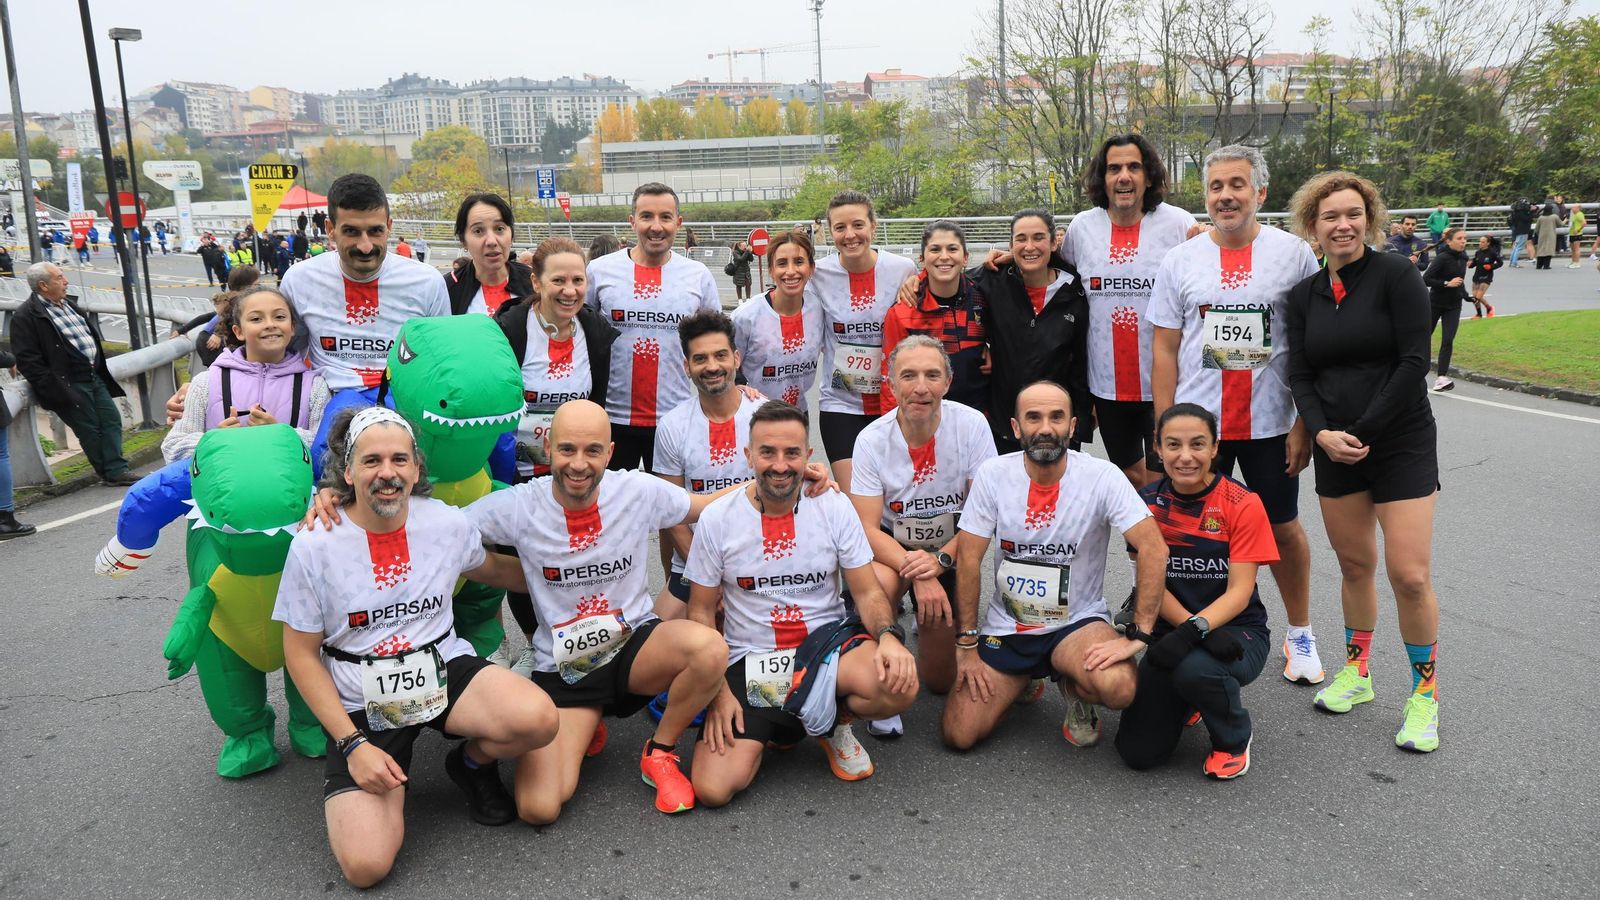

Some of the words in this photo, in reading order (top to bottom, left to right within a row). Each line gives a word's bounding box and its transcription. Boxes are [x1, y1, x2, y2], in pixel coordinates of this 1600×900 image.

[251, 165, 284, 179] CAIXÓN
[287, 165, 294, 179] 3
[1089, 290, 1152, 299] www.storespersan.c
[627, 310, 685, 324] PERSAN
[614, 321, 682, 331] www.storespersan.co
[846, 321, 886, 334] PERSA
[1213, 324, 1253, 342] 1594
[339, 338, 395, 352] PERSA
[776, 360, 818, 377] PERSAN
[846, 355, 873, 371] 978
[705, 475, 756, 492] PERS
[905, 491, 965, 513] PERSAN
[905, 525, 945, 541] 1526
[563, 555, 633, 581] PERSAN
[757, 570, 828, 589] PERSAN
[1006, 575, 1048, 598] 9735
[371, 594, 444, 623] PERSAN
[563, 628, 612, 655] 9658
[758, 655, 797, 674] 159
[376, 667, 426, 695] 1756
